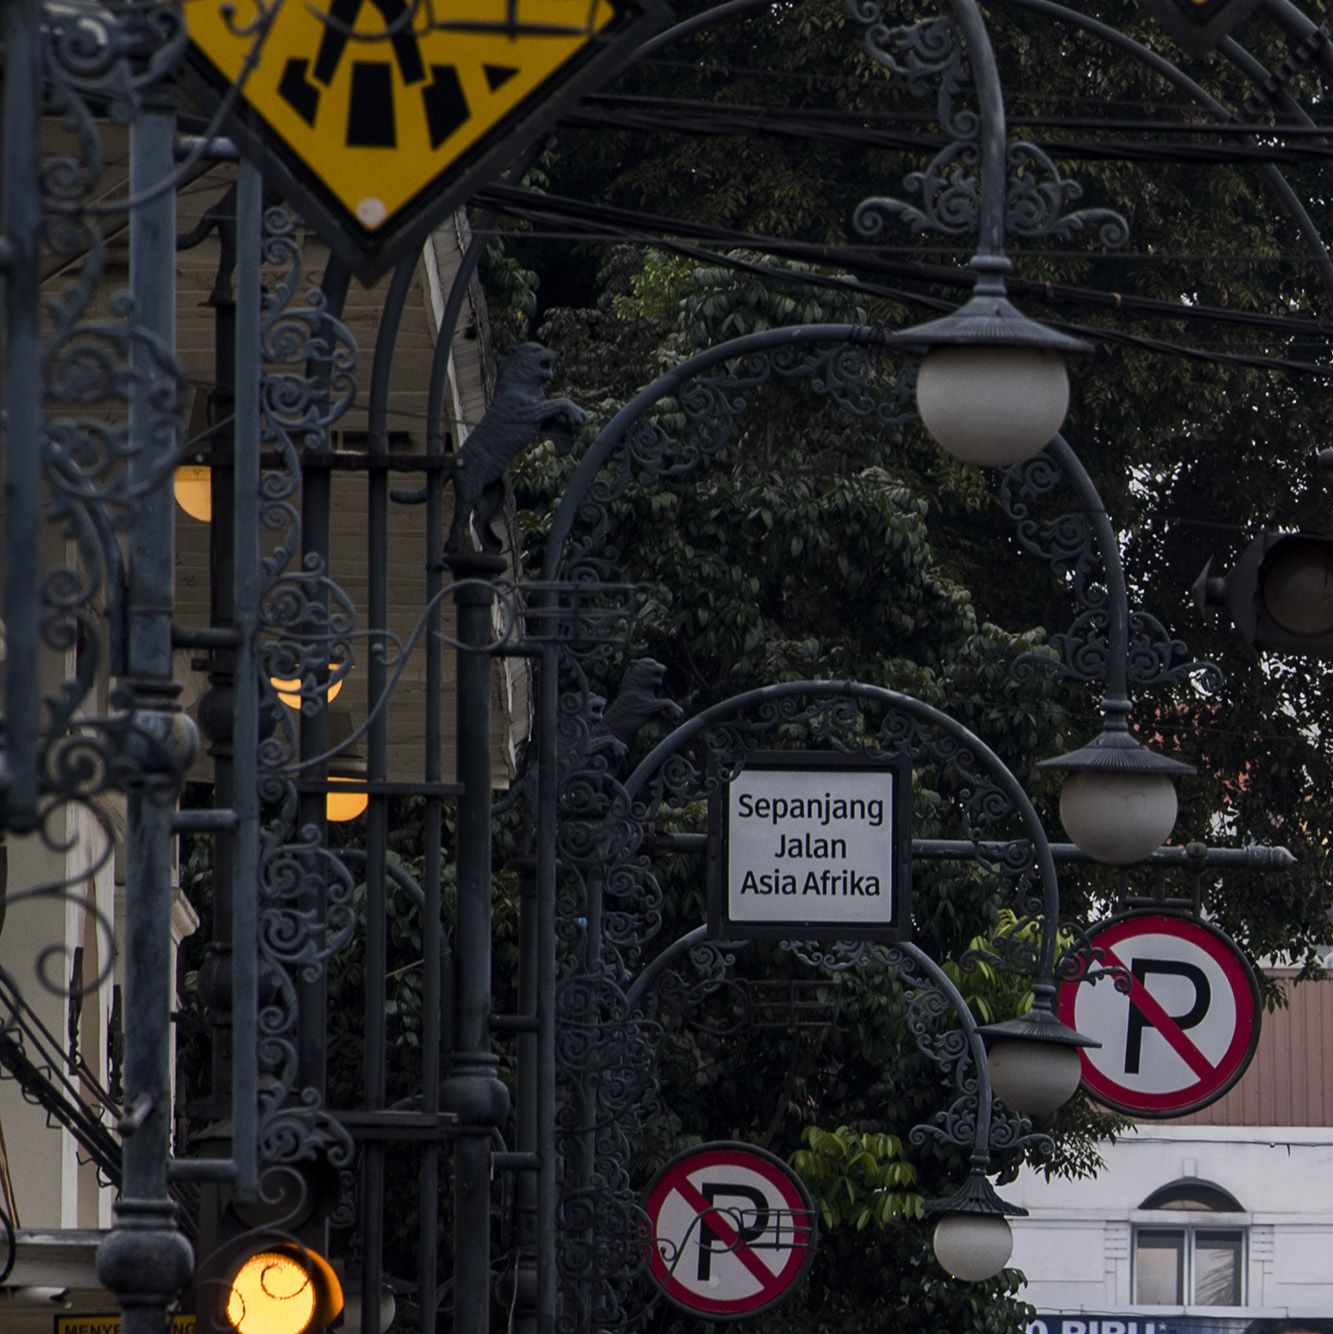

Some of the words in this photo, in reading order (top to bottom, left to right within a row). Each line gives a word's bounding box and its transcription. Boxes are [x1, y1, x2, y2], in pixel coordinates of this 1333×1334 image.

[737, 792, 884, 827] Sepanjang
[773, 833, 848, 860] Jalan
[740, 869, 798, 896] Asia
[802, 869, 881, 897] Afrika
